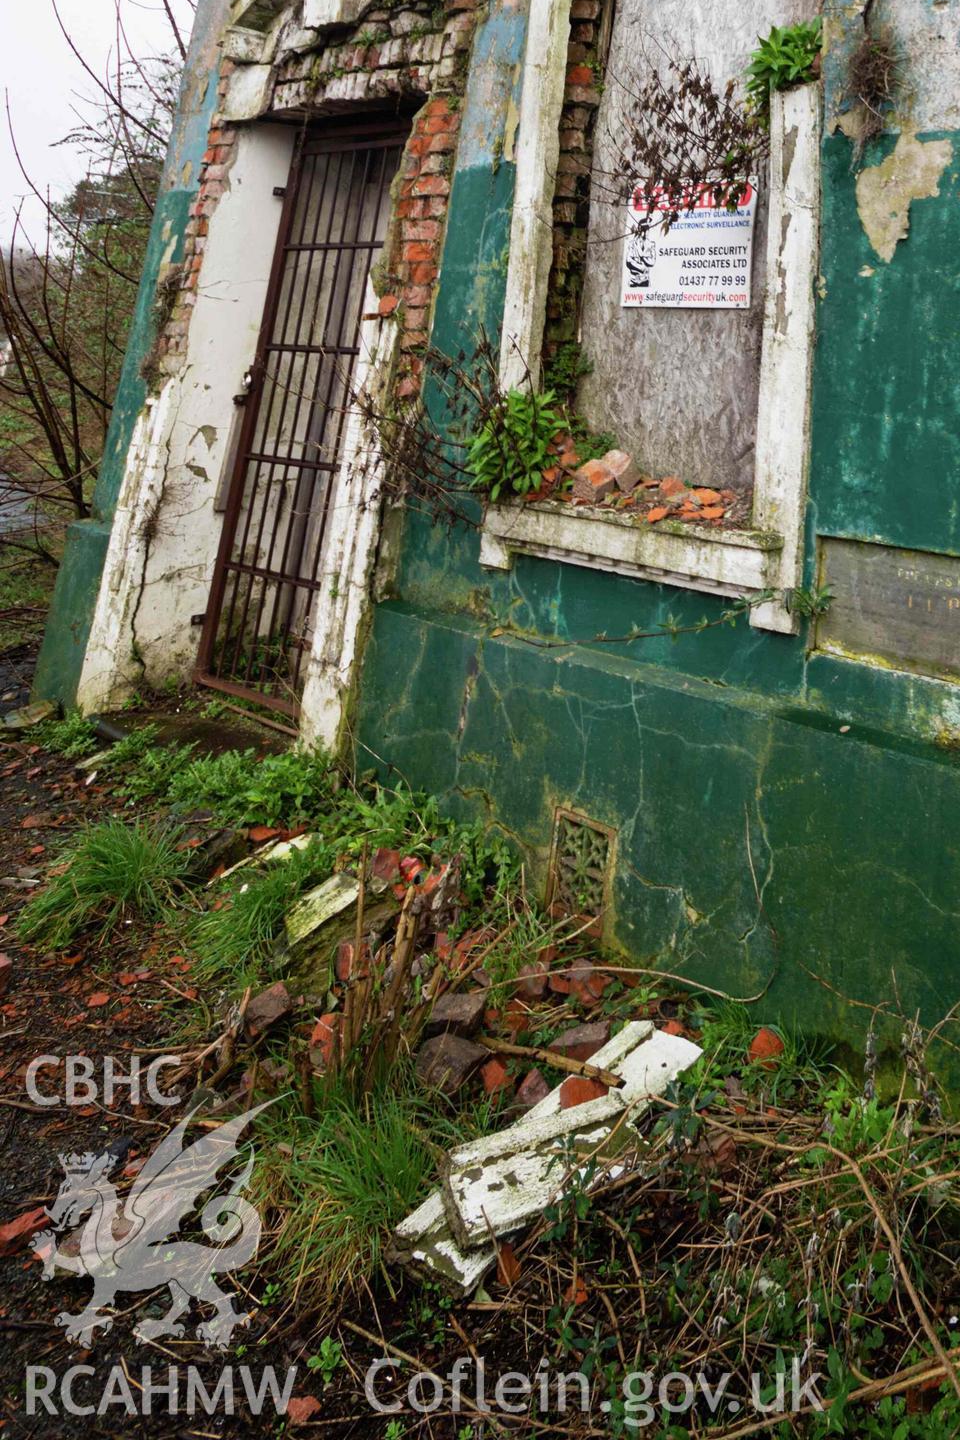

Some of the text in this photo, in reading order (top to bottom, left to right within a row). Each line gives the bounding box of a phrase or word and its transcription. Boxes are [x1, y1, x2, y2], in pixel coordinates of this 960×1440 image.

[683, 211, 711, 219] SECURITY
[670, 220, 750, 230] ELECTRONIC SURVEILLANCE
[658, 246, 748, 257] SAFEGUARD SECURITY
[681, 259, 747, 269] ASSOCIATES LTD
[679, 275, 746, 286] 01437 77 99 99
